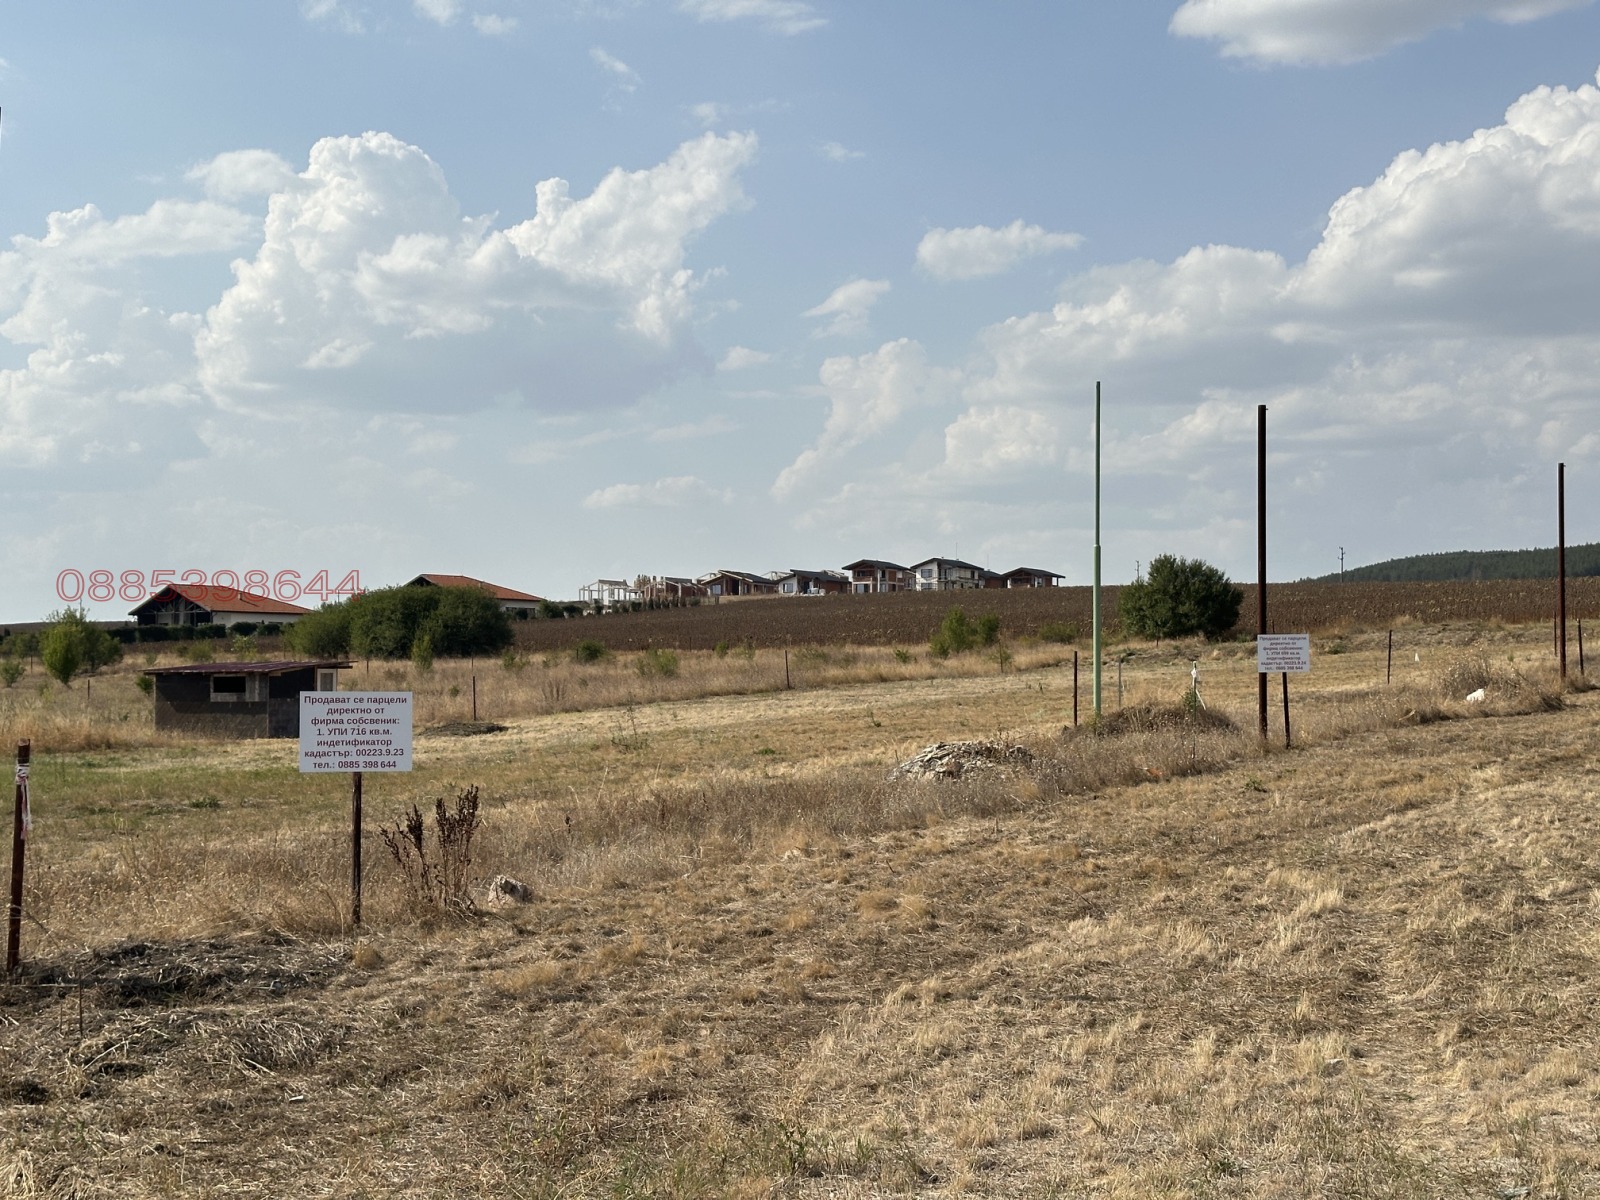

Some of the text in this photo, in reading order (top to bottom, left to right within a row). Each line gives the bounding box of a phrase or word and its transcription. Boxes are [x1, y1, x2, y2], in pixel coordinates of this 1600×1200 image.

[304, 695, 351, 705] Продават
[366, 697, 407, 705] парцели
[326, 707, 372, 716] директно
[311, 717, 400, 726] фирма собсвеник:
[316, 728, 325, 736] 1.
[327, 728, 348, 736] УПИ
[350, 727, 367, 736] 716
[316, 738, 392, 748] индетификатор
[304, 748, 404, 758] кадастър: 00223.9.23
[313, 760, 397, 769] тел.: 0885 398 644
